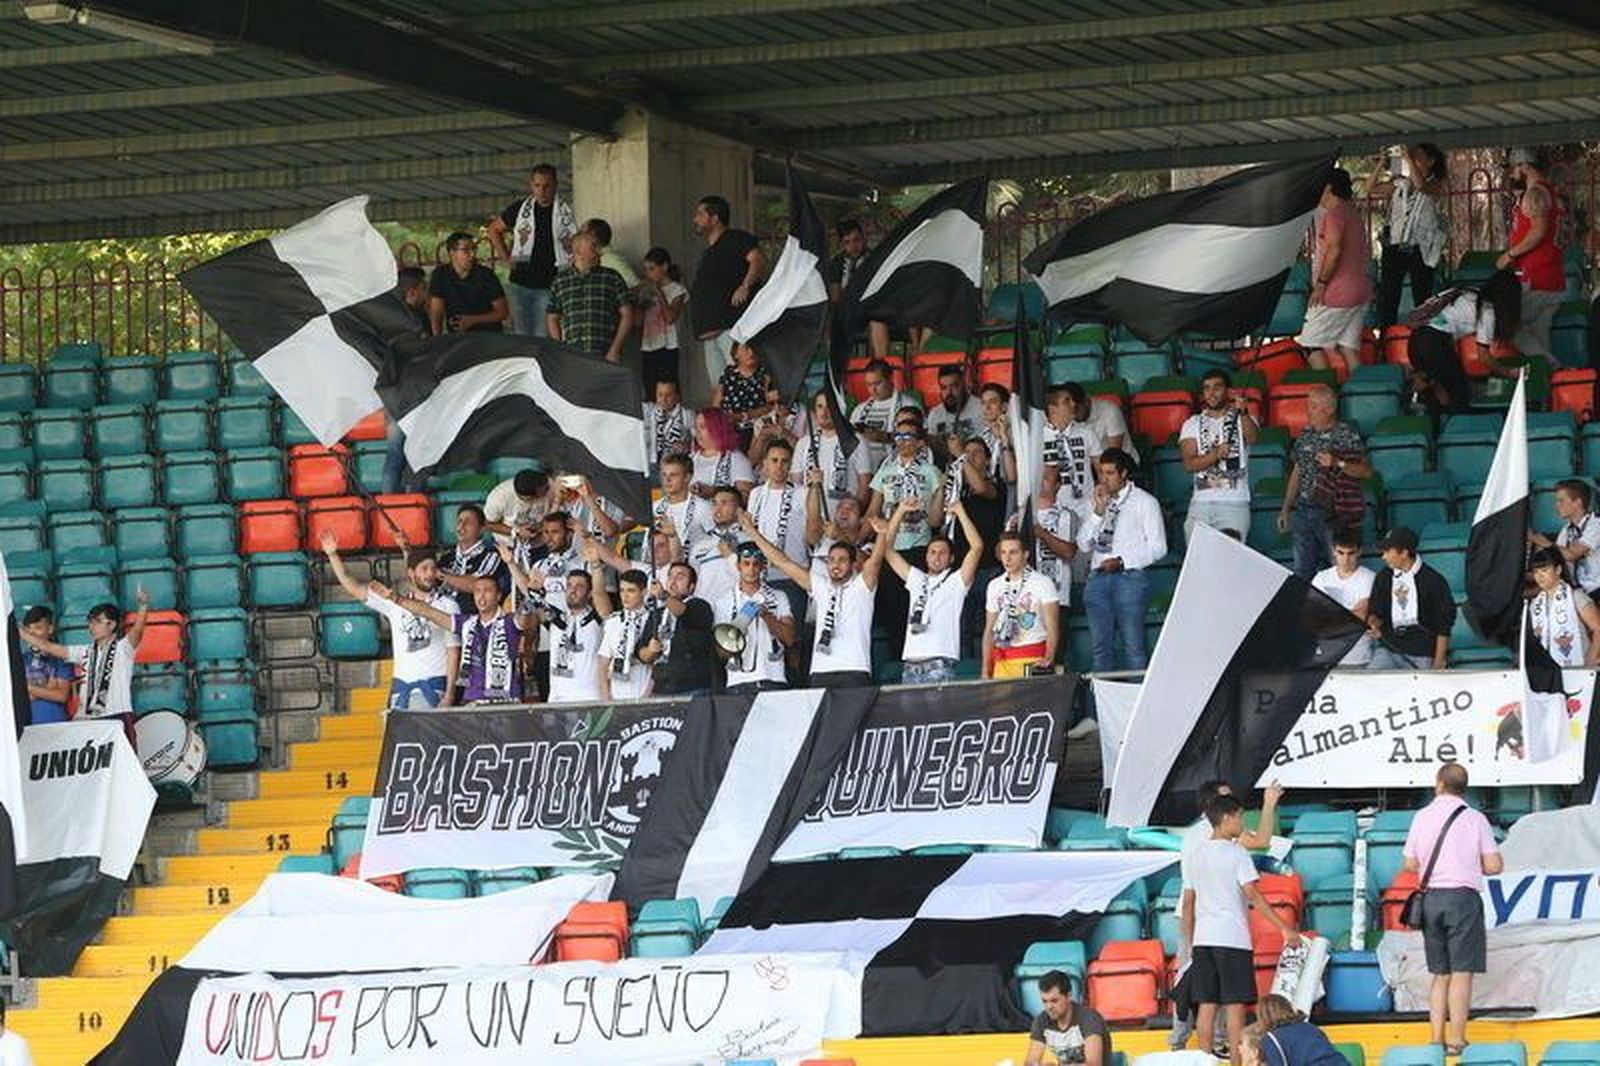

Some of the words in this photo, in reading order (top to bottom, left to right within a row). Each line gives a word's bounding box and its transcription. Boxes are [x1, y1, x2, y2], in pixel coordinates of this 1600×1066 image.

[620, 717, 684, 739] BASTION
[1273, 690, 1473, 766] almantino
[29, 739, 115, 780] UNIÓN
[1388, 733, 1474, 764] Alé!
[326, 772, 348, 789] 14
[803, 712, 1054, 822] UINEGRO
[377, 739, 622, 835] BASTION
[266, 834, 290, 851] 13
[208, 887, 229, 905] 12
[79, 1011, 102, 1032] 10
[204, 990, 344, 1061] UNIDOS
[351, 983, 448, 1055] POR
[466, 980, 534, 1048] UN
[554, 965, 730, 1044] SUEÑO
